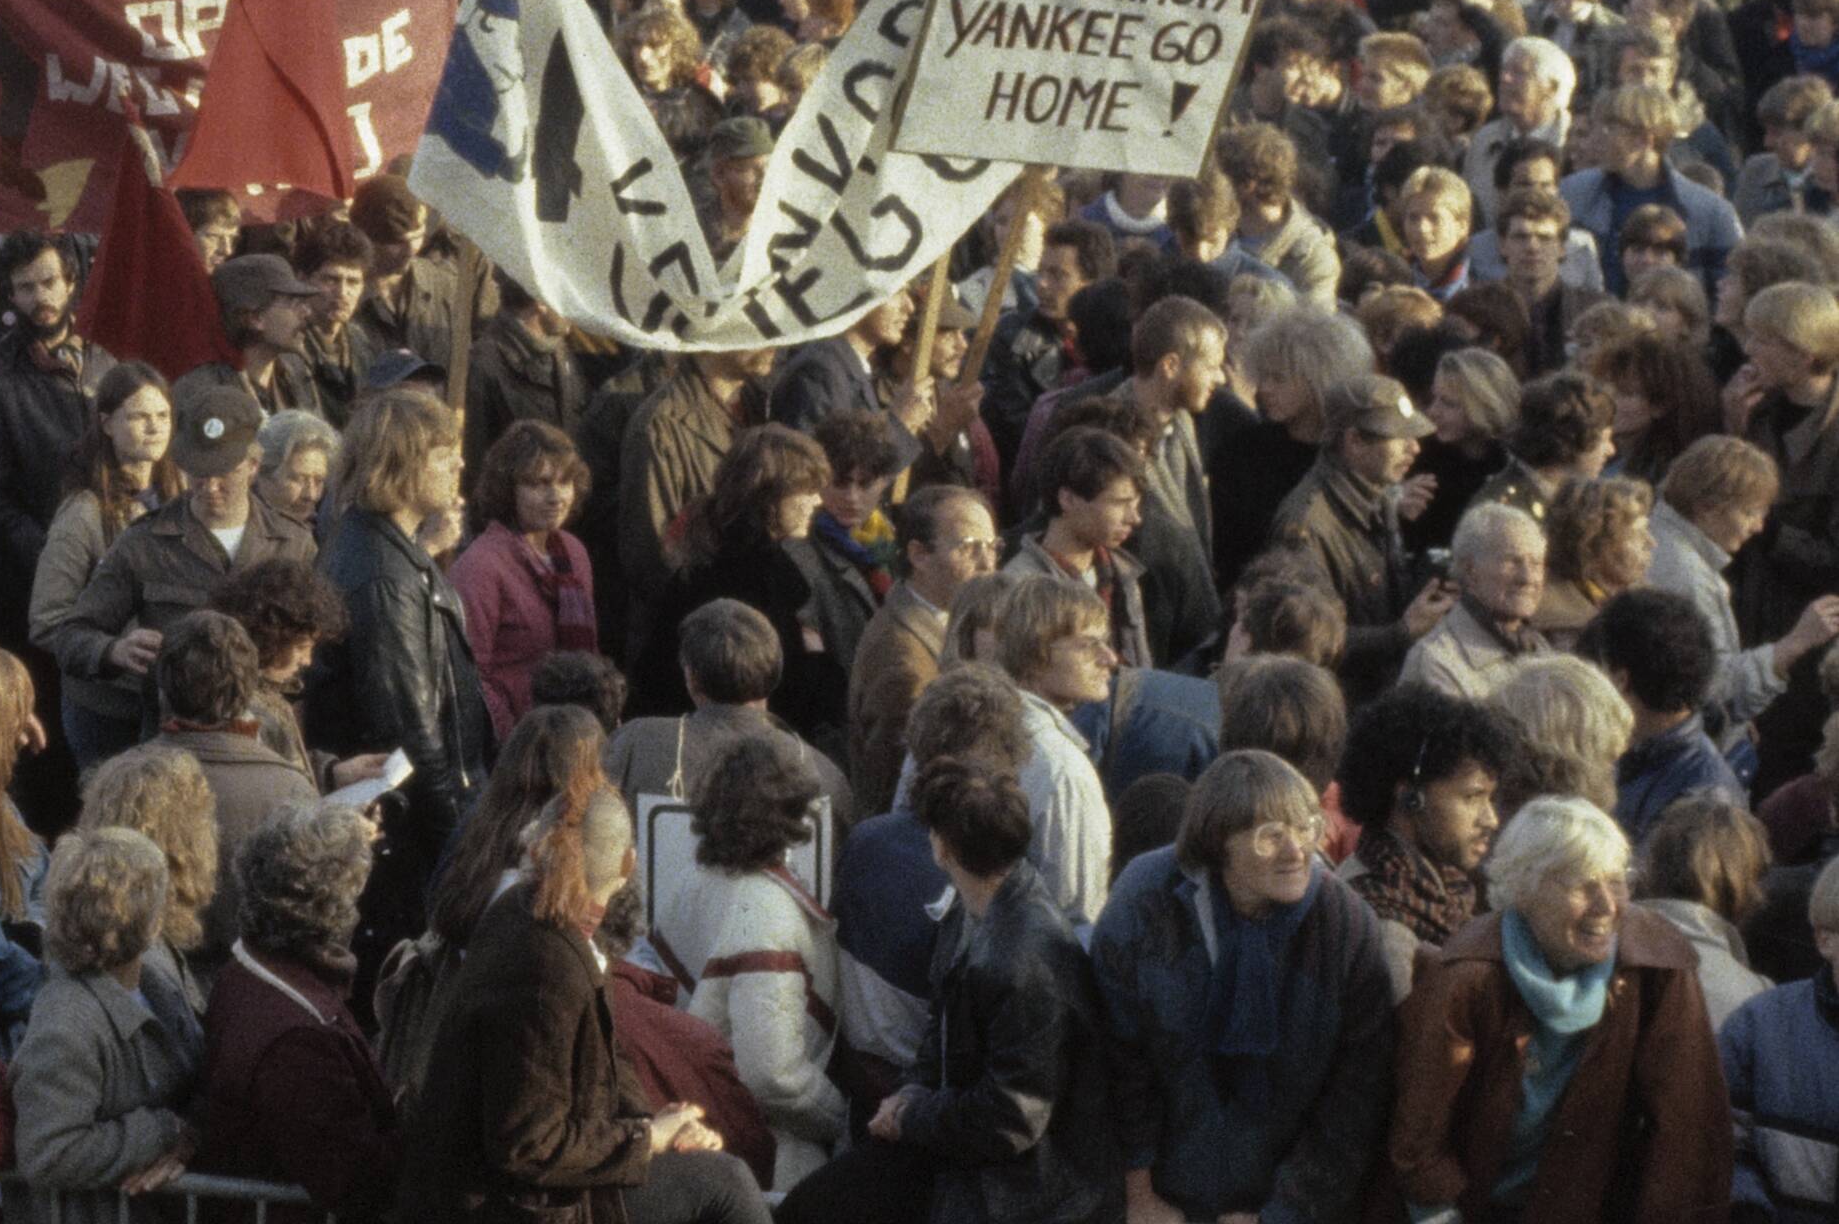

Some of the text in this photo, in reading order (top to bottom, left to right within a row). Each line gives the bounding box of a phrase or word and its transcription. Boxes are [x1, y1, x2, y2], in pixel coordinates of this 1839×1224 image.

[342, 8, 414, 88] DE
[1150, 20, 1223, 66] GO
[983, 70, 1143, 133] HOME
